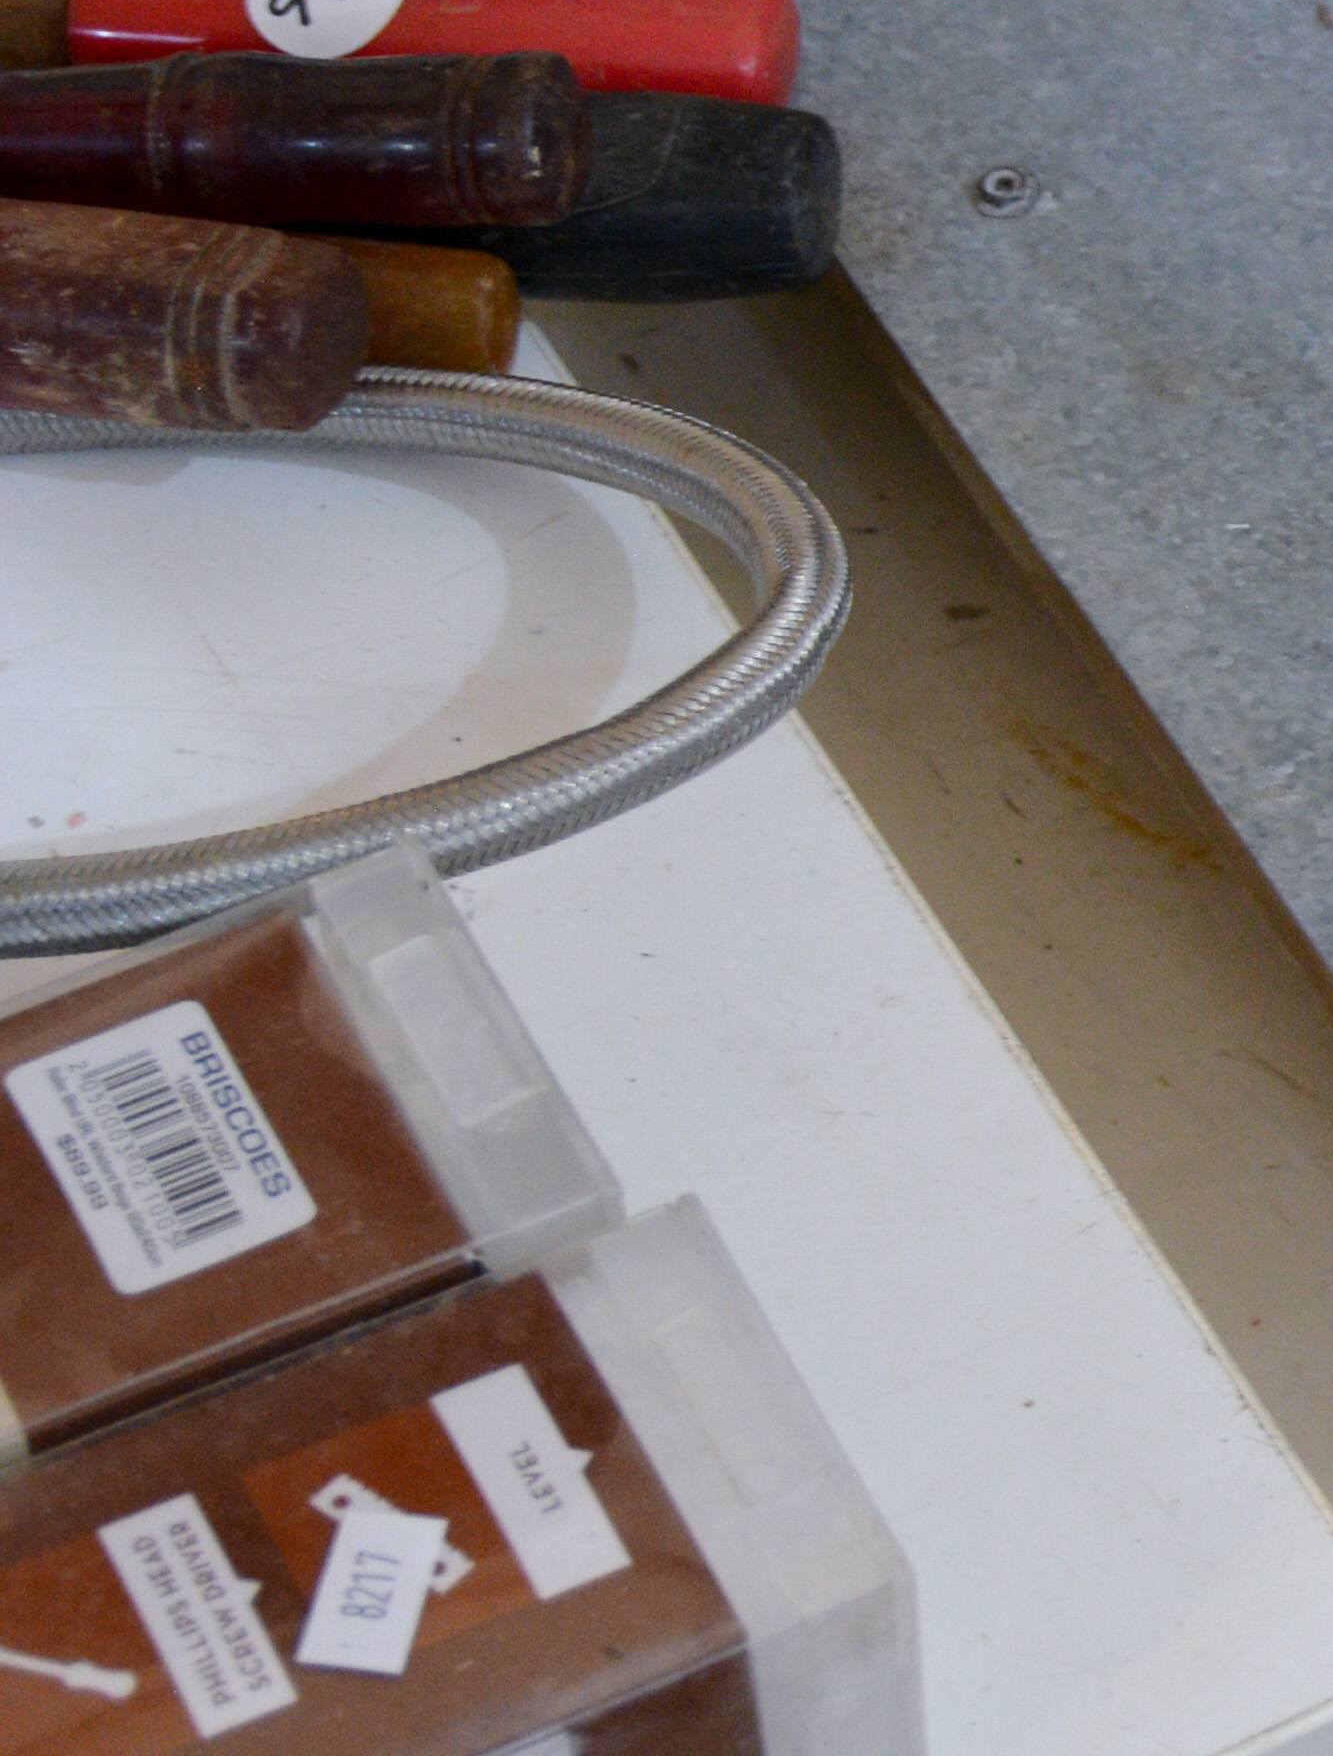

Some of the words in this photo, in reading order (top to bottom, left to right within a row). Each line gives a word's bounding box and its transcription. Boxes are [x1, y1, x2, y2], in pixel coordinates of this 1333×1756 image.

[180, 1030, 292, 1198] BRISCOES
[507, 1440, 564, 1517] LEVEL
[130, 1533, 181, 1601] HEAD
[166, 1518, 227, 1605] DRIVER
[339, 1548, 408, 1623] 8217
[164, 1597, 237, 1709] PHILLIPS
[211, 1603, 272, 1693] SCREW
